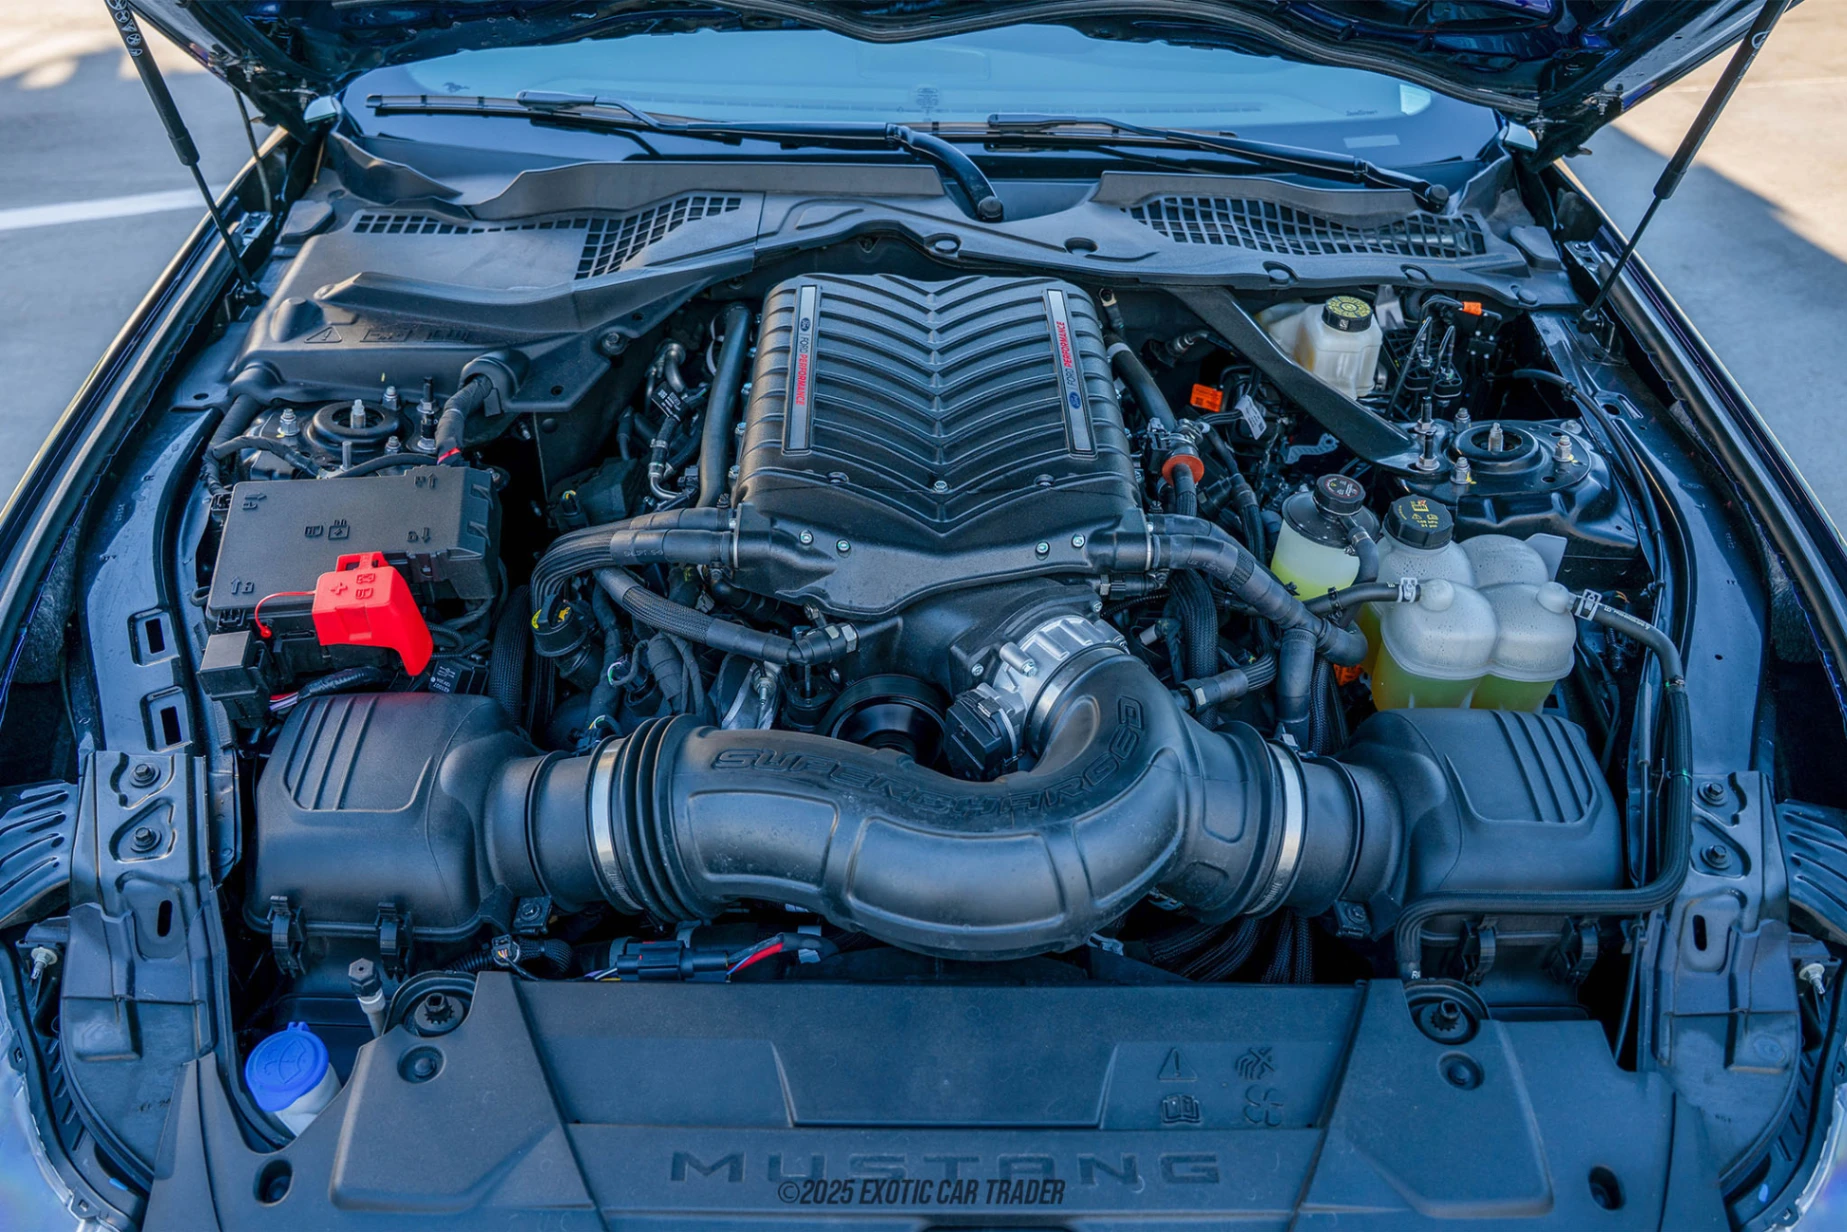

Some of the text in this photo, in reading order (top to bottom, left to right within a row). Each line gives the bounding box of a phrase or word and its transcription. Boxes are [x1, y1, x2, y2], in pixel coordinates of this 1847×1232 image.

[799, 337, 809, 353] FORD
[1056, 321, 1073, 368] PERFORMANCE
[796, 354, 808, 406] PERFORMANCE
[1065, 368, 1076, 386] FORD
[710, 695, 1143, 814] SUPERCHARGED
[670, 1152, 1220, 1185] MUSTANG
